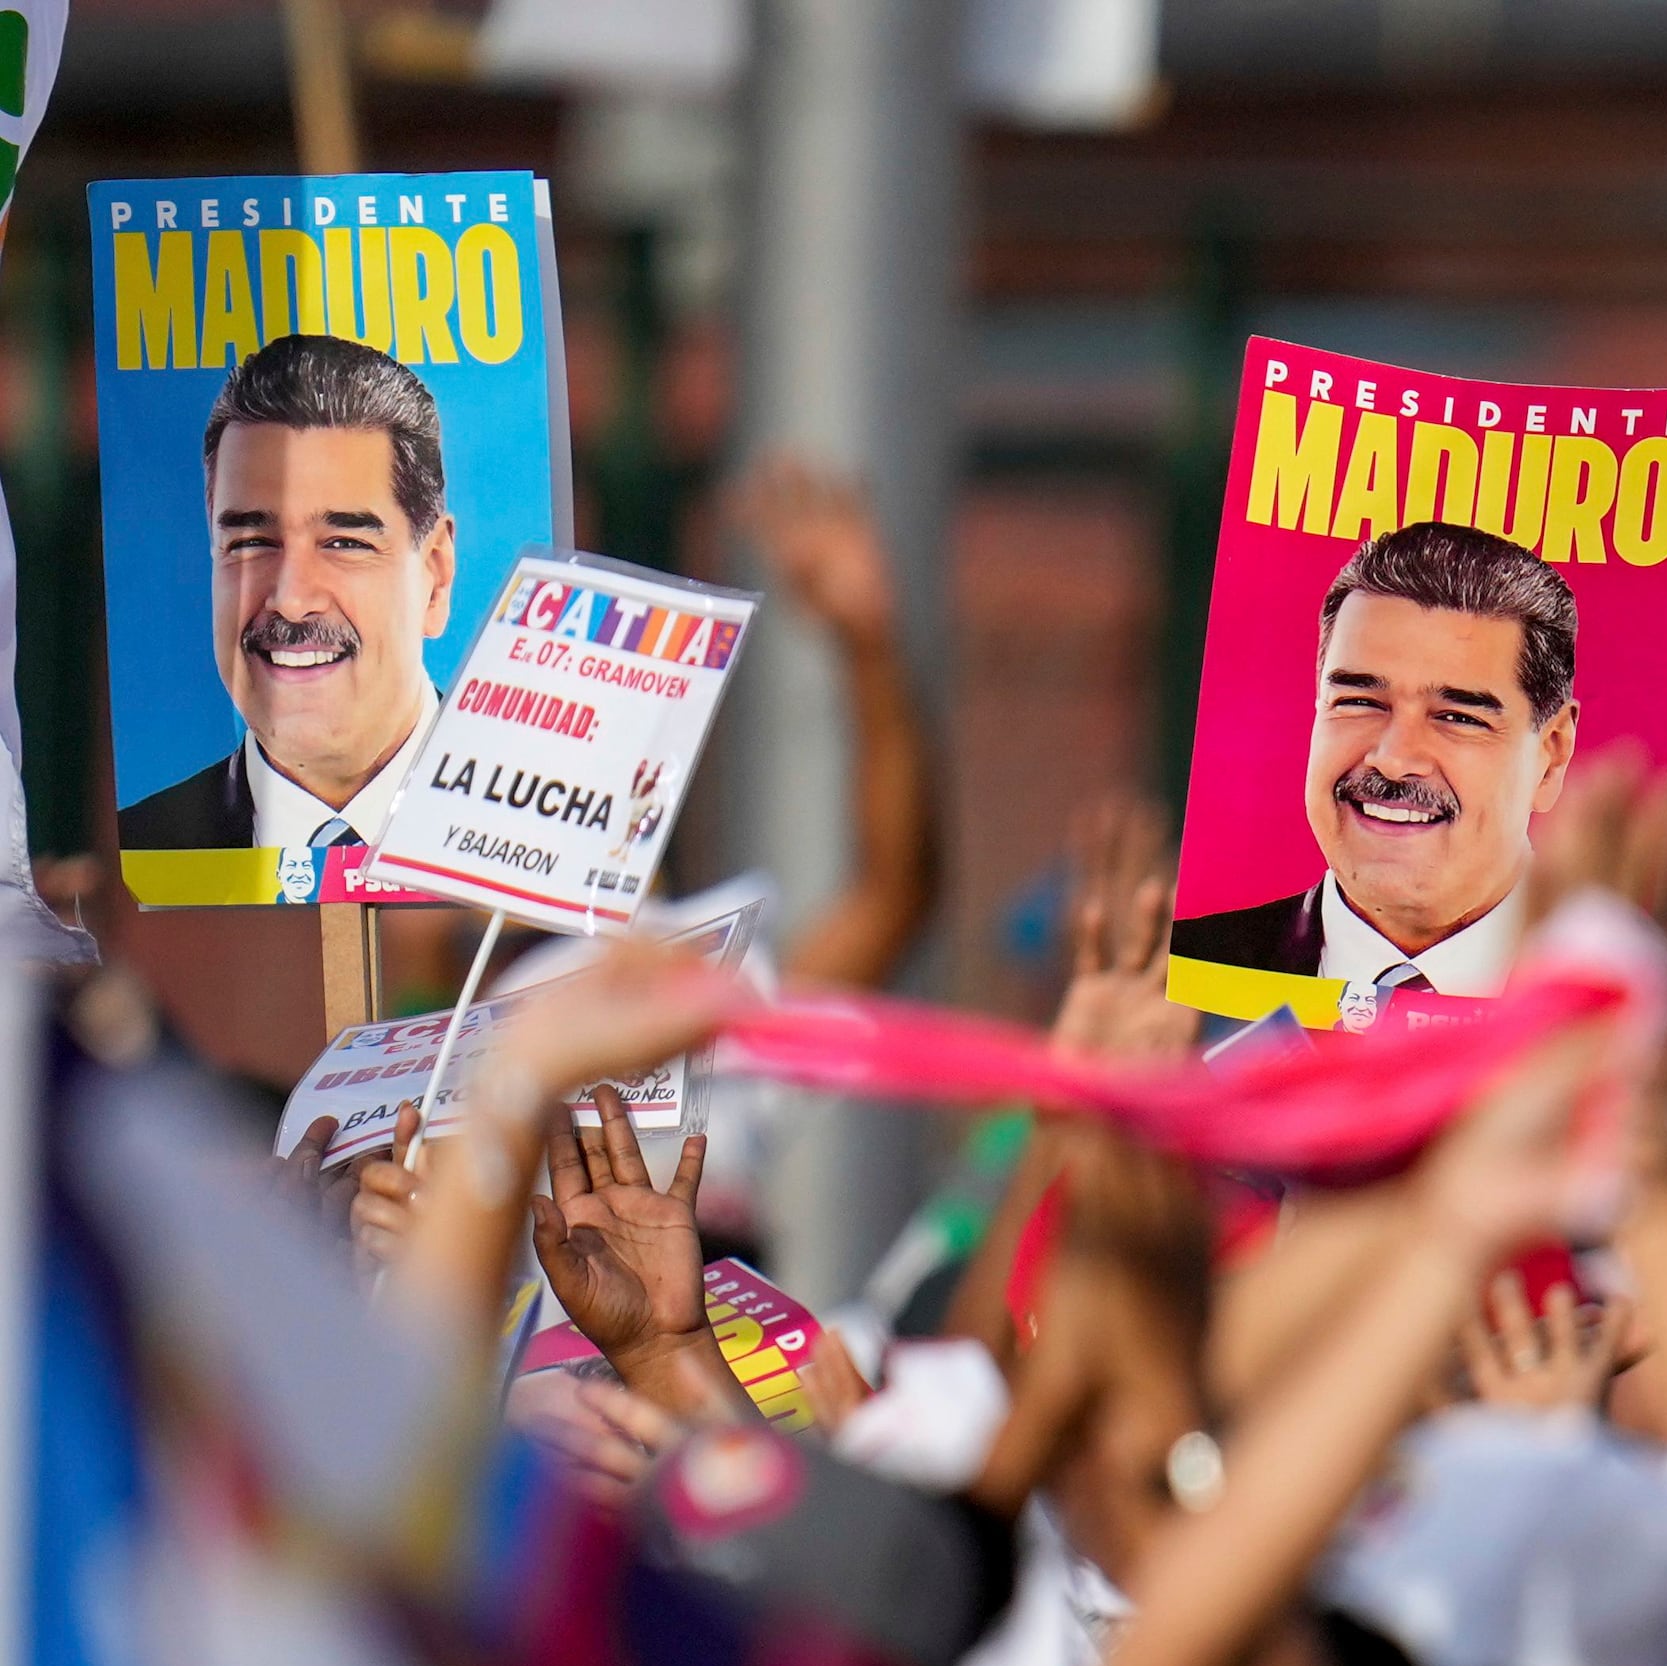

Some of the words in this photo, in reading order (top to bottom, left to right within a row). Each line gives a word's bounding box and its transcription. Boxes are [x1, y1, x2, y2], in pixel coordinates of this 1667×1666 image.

[111, 193, 508, 230] PRESIDENTE
[113, 223, 523, 370] MADURO
[526, 581, 714, 666] CATIA
[536, 640, 572, 672] 07:
[578, 655, 691, 699] GRAMOVEN
[457, 678, 600, 742] COMUNIDAD:
[430, 753, 477, 796] LA
[483, 765, 614, 831] LUCHA
[442, 825, 460, 848] Y
[457, 830, 560, 876] BAJARON
